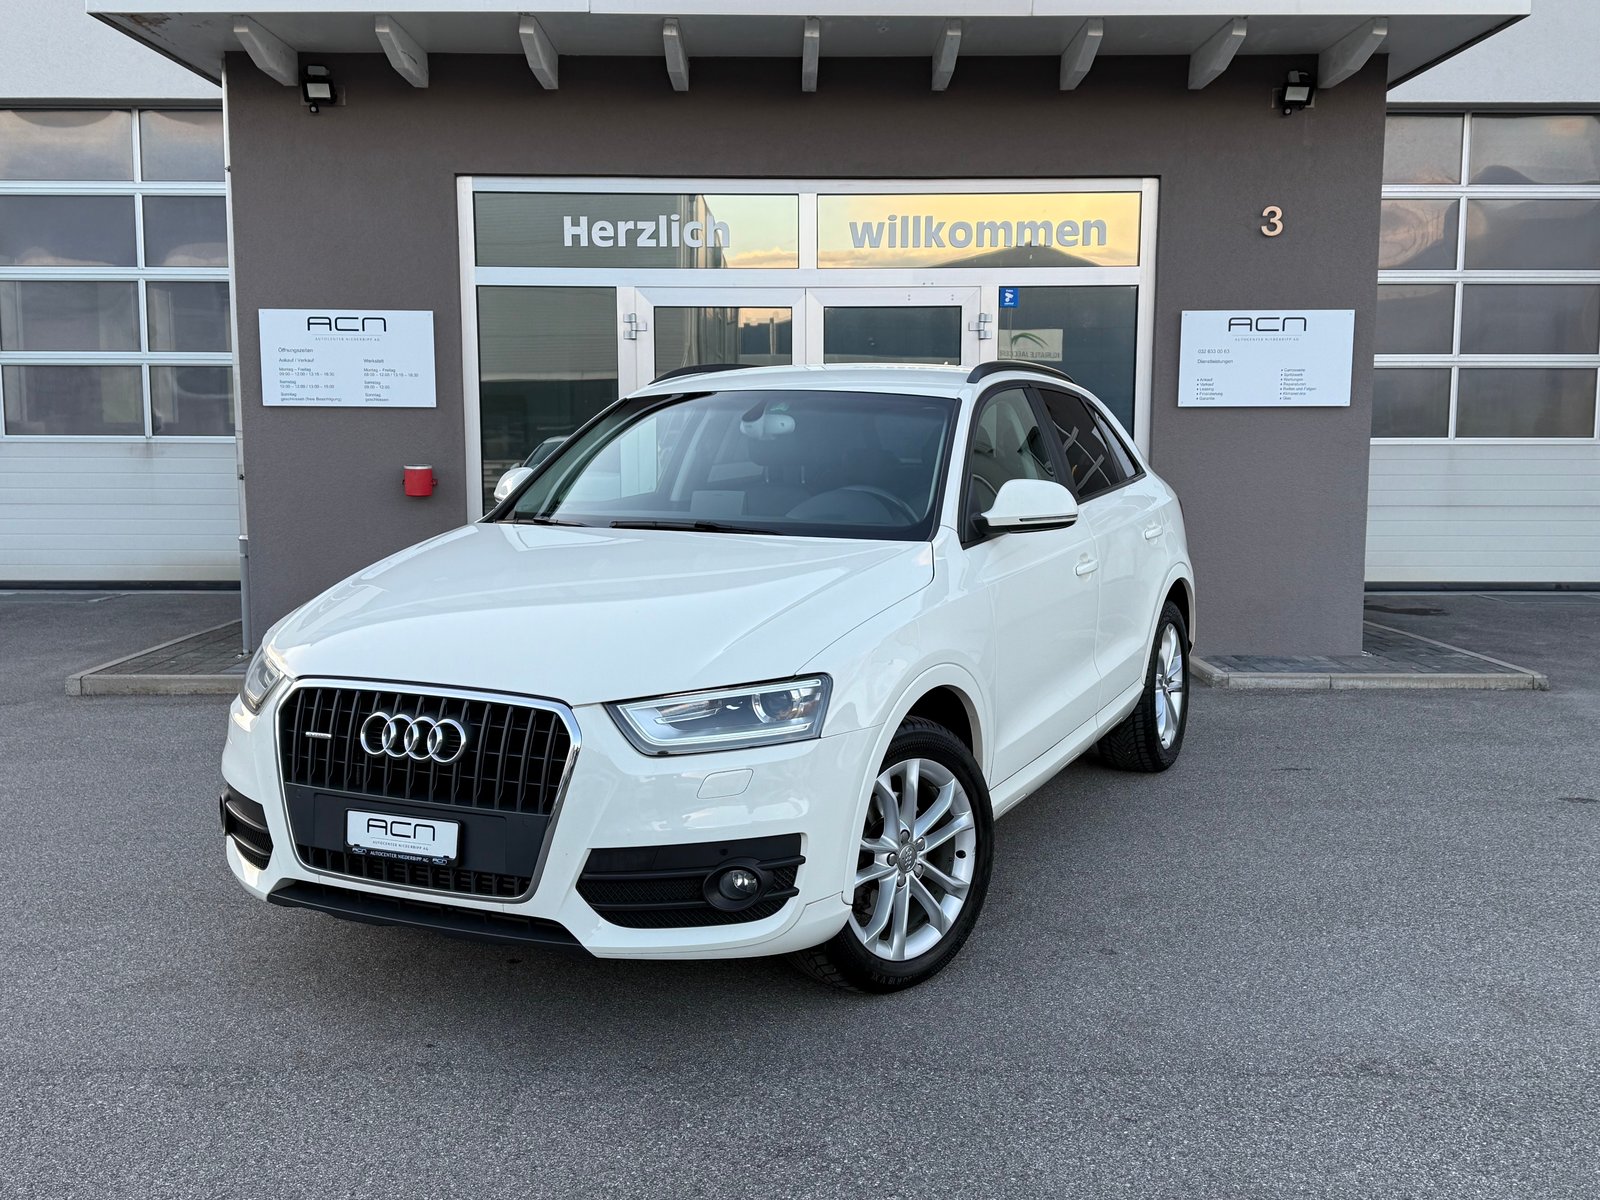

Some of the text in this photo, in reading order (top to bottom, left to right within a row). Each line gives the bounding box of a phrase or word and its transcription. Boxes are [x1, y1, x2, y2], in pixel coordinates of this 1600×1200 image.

[563, 214, 1107, 248] Herzlich willkommen
[1261, 206, 1284, 238] 3
[307, 316, 386, 332] ACN
[1228, 317, 1307, 332] ACN
[367, 818, 435, 841] ACN
[370, 851, 397, 859] AUTOCENTER
[398, 853, 423, 862] NIEDERBIPP
